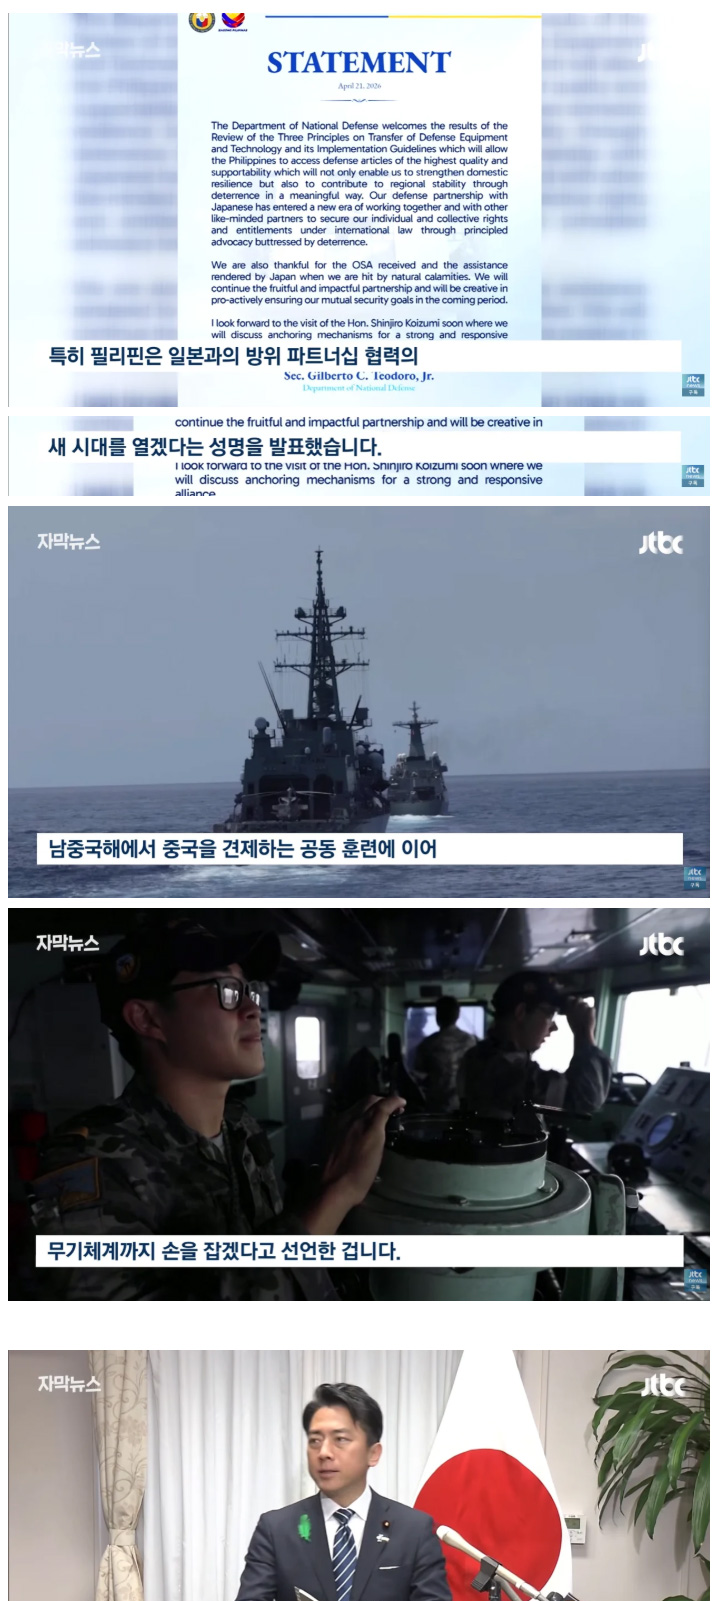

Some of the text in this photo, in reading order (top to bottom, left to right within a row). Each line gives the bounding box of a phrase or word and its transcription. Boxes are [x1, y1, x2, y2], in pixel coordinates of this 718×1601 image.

[268, 51, 452, 73] STATEMENT
[338, 82, 354, 91] April
[211, 121, 508, 131] The Department of National Defense welcomes the results of the
[211, 261, 227, 269] We
[251, 261, 268, 269] also
[274, 261, 309, 269] thankful
[315, 261, 327, 269] for
[332, 261, 347, 269] the
[352, 261, 373, 269] OSA
[378, 261, 416, 269] received
[421, 261, 438, 269] and
[443, 261, 458, 269] the
[463, 261, 508, 269] assistance
[303, 384, 345, 394] Department
[388, 384, 416, 392] Defense
[175, 474, 193, 484] will
[199, 474, 238, 484] discuss
[245, 474, 300, 487] anchoring
[307, 474, 375, 484] mechanisms
[382, 474, 397, 484] for
[416, 476, 451, 487] strong
[458, 475, 478, 484] and
[485, 474, 543, 487] responsive
